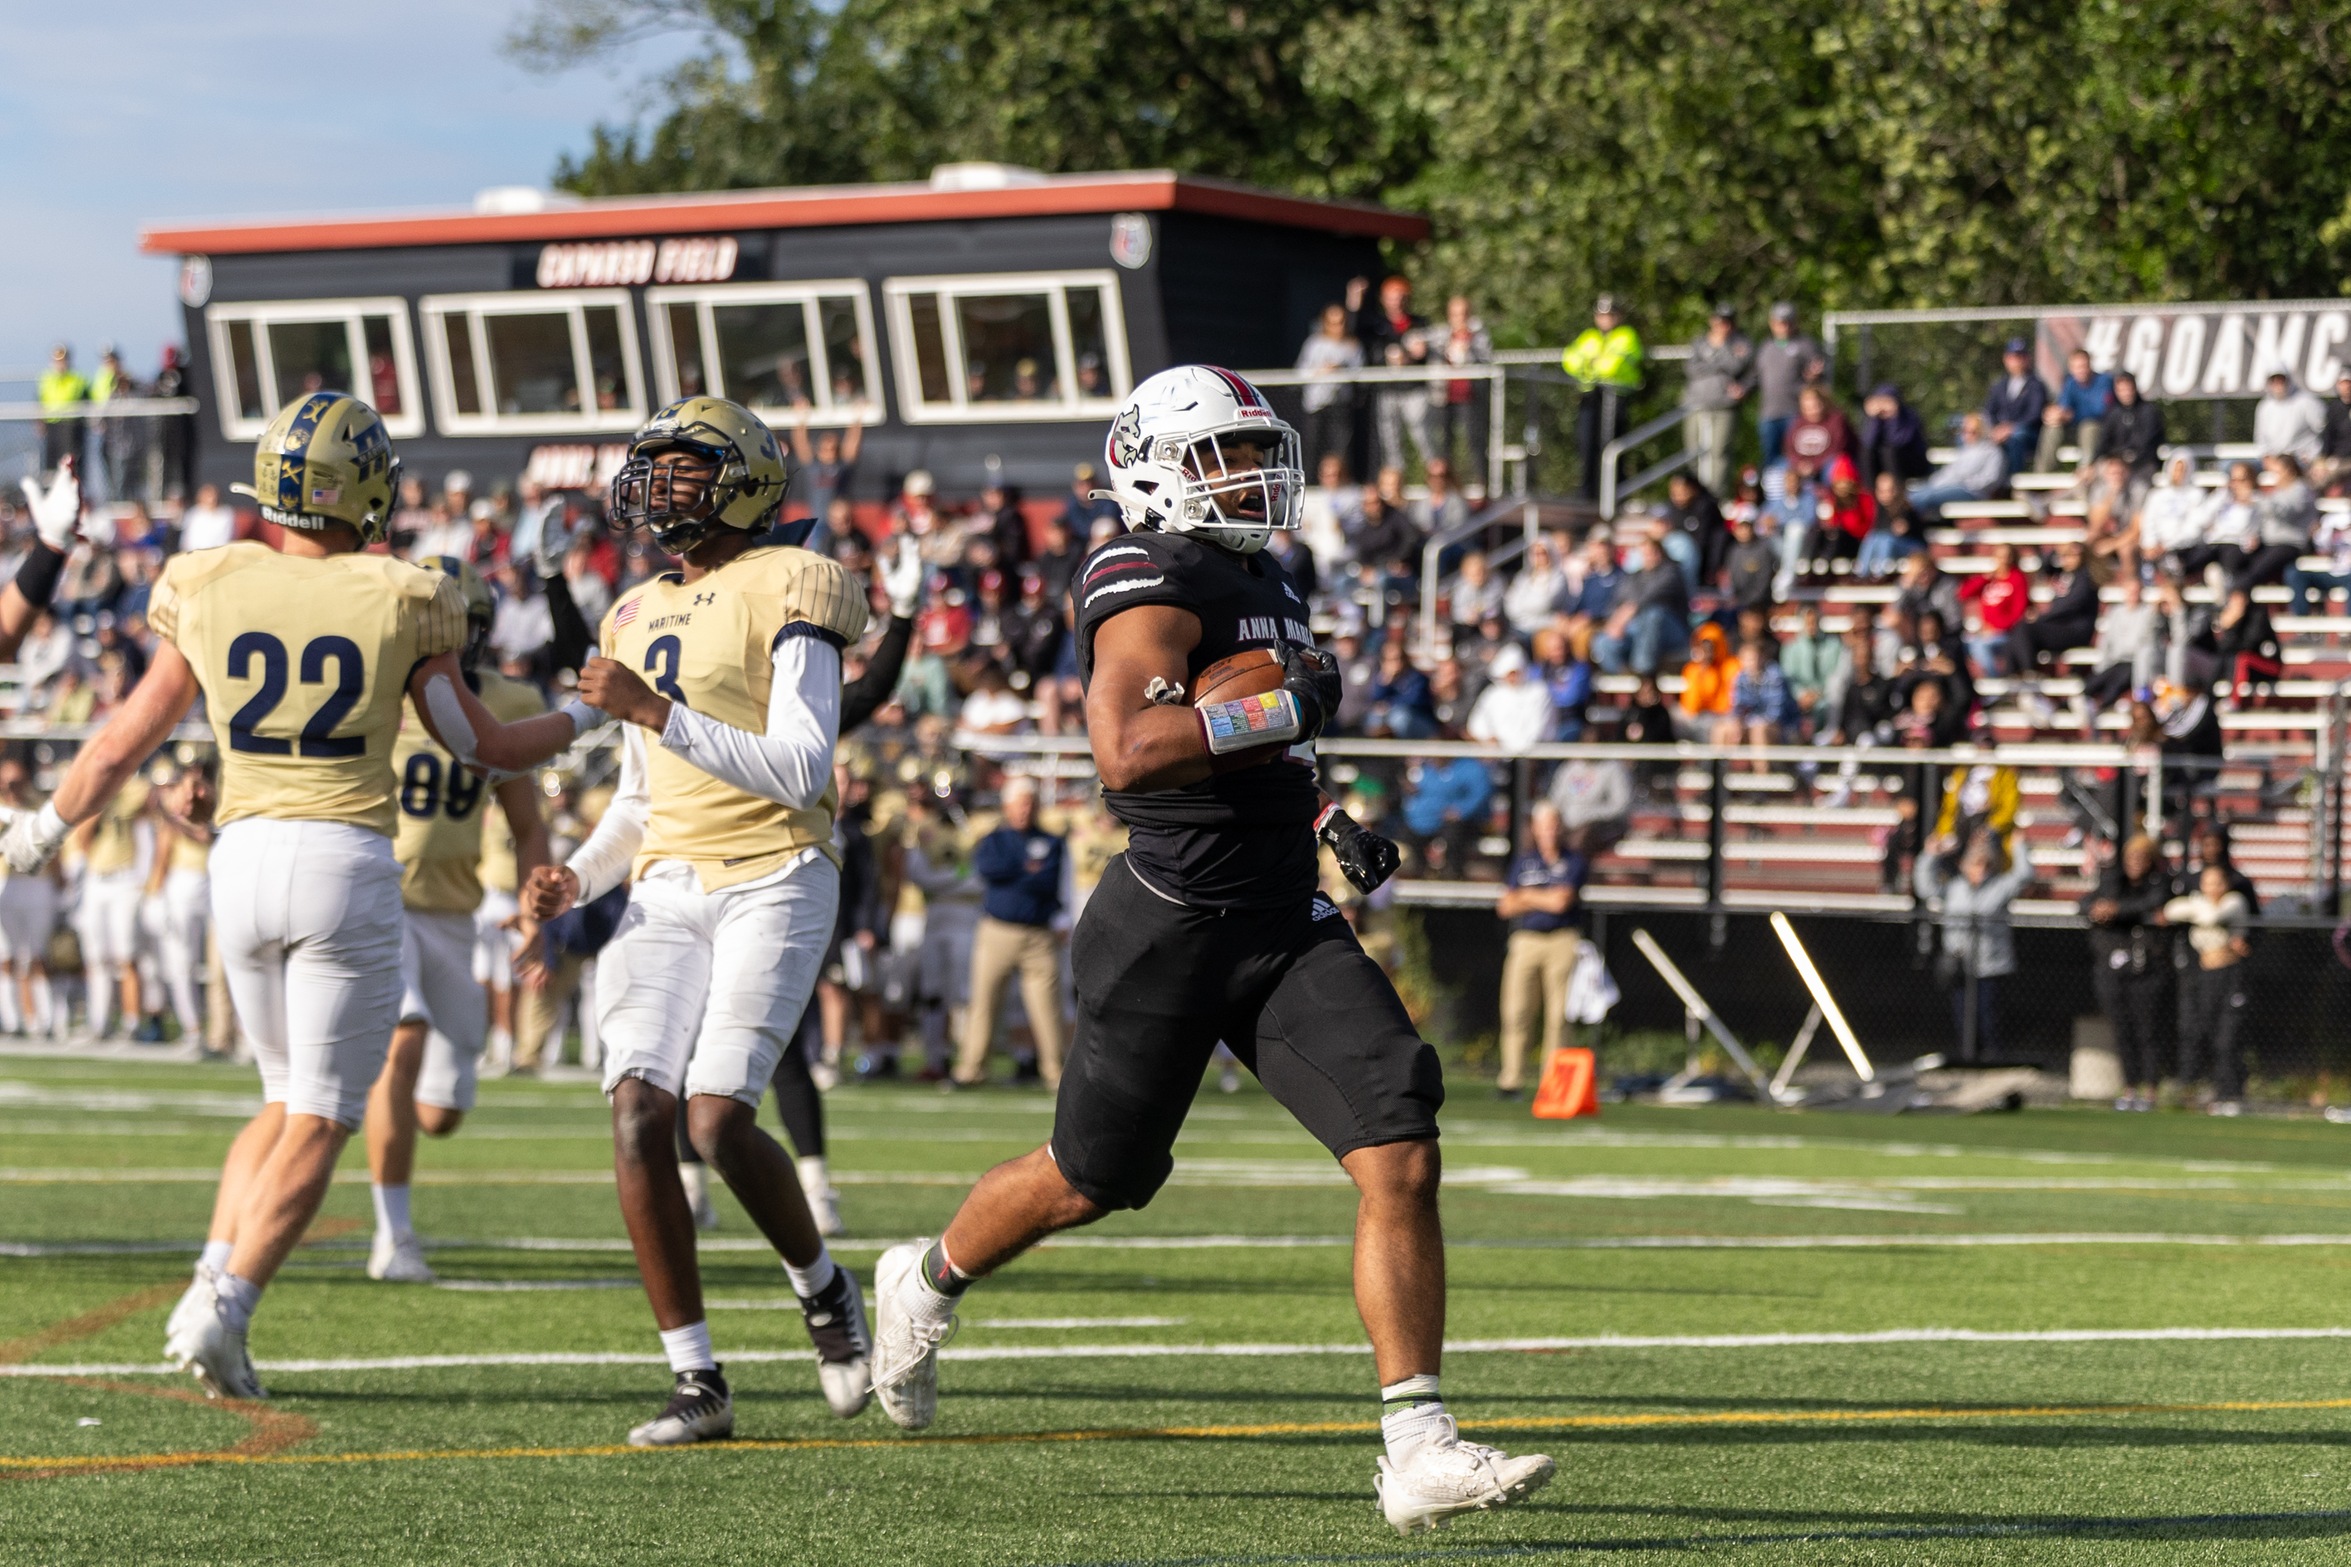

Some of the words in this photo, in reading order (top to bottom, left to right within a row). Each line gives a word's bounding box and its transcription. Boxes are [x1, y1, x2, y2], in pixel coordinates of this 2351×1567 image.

[655, 236, 738, 283] FIELD
[1241, 408, 1272, 418] Riddell
[261, 506, 325, 530] Riddell
[648, 613, 692, 633] MARITIME
[1238, 617, 1279, 641] ANNA
[644, 634, 689, 708] 3
[227, 631, 366, 758] 22
[401, 753, 482, 819] 89
